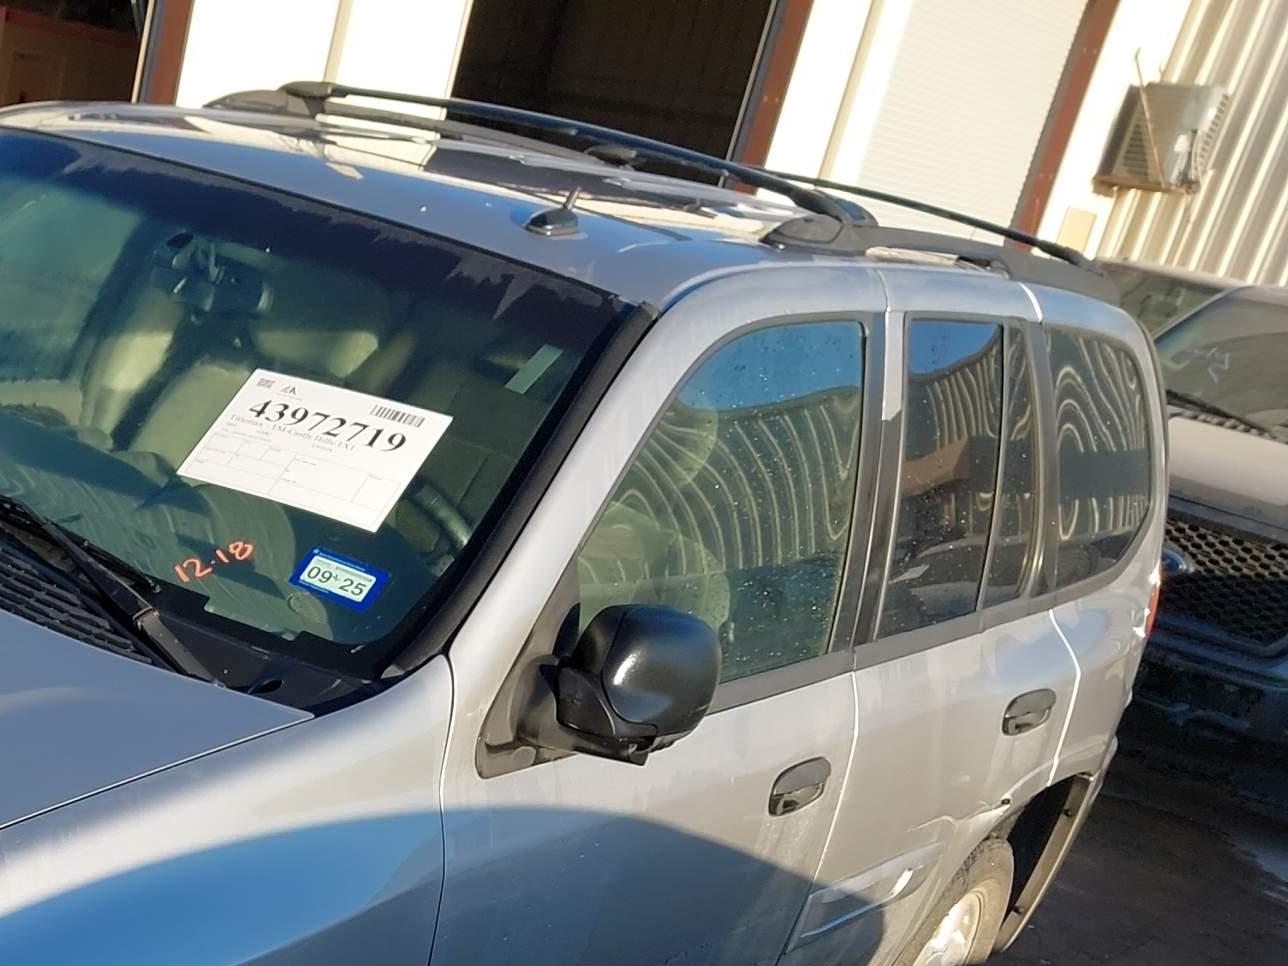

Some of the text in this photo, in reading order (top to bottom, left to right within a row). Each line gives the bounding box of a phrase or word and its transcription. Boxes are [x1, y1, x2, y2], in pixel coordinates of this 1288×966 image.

[249, 399, 407, 453] 43972719
[307, 566, 333, 584] 09
[339, 578, 367, 596] 25
